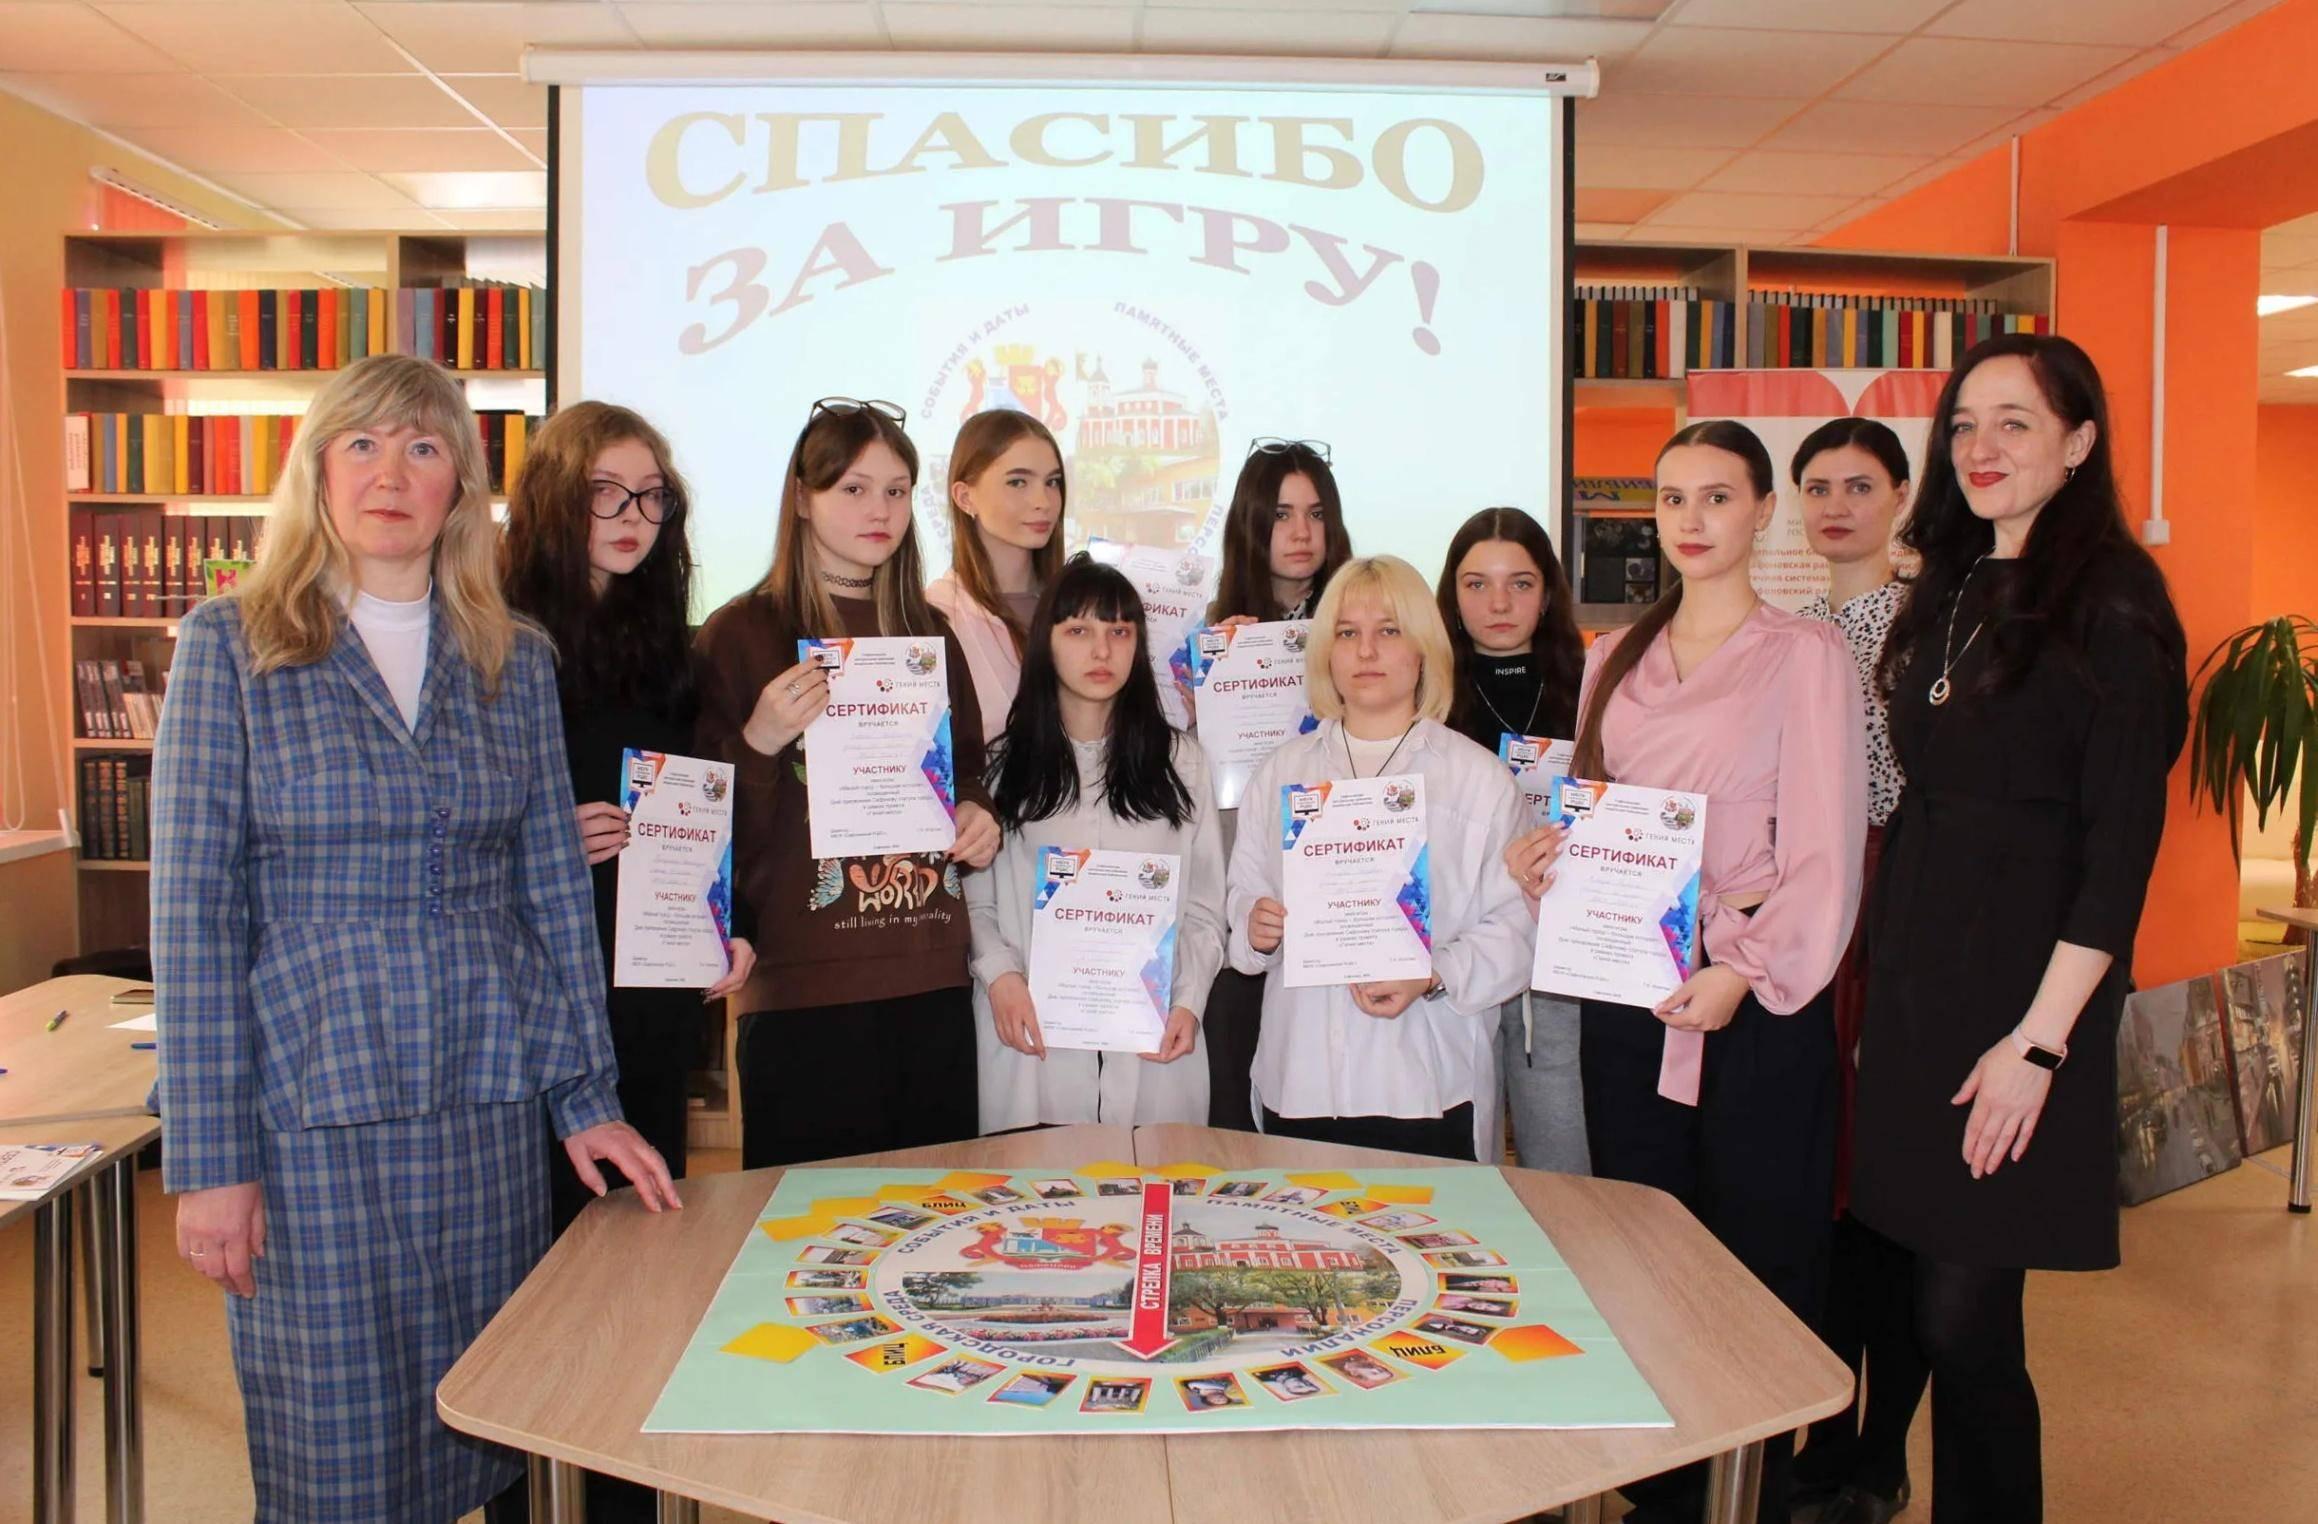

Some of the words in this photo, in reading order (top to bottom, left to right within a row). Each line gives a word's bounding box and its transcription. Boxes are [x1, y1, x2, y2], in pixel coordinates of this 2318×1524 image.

[644, 111, 1486, 214] СПАСИБО
[678, 220, 895, 357] ЗА
[935, 198, 1443, 357] ИГРУ!
[921, 343, 969, 420] СОБЫТИЯ
[969, 331, 982, 344] И
[984, 303, 1030, 335] ДАТЫ
[1114, 301, 1200, 364] ПАМЯТНЫЕ
[1197, 363, 1229, 421] МЕСТА
[1187, 503, 1224, 556] ПЕРСО
[1143, 602, 1188, 618] ФИКАТ
[1495, 666, 1527, 676] INSPIRE
[1213, 674, 1304, 693] СЕРТИФИКАТ
[826, 702, 928, 718] СЕРТИФИКАТ
[1238, 730, 1285, 740] УЧАСТНИКУ
[853, 765, 906, 775] УЧАСТНИКУ
[638, 822, 717, 843] СЕРТИФИКАТ
[1304, 838, 1405, 857] СЕРТИФИКАТ
[1569, 843, 1677, 870] СЕРТИФИКАТ
[654, 891, 697, 903] УЧАСТНИКУ
[1328, 898, 1382, 909] УЧАСТНИКУ
[833, 916, 857, 930] still
[861, 916, 886, 928] living
[889, 913, 900, 924] in
[904, 916, 918, 927] my
[1055, 908, 1155, 926] СЕРТИФИКАТ
[1586, 909, 1643, 925] УЧАСТНИКУ
[1073, 967, 1125, 977] УЧАСТНИКУ
[922, 1201, 967, 1209] БЛИЦ
[897, 1215, 981, 1254] СОБЫТИЯ
[1007, 1201, 1076, 1212] ДАТЫ
[1143, 1214, 1164, 1255] ВРЕМЕНИ
[1206, 1199, 1344, 1227] ПАМЯТНЫЕ
[1345, 1226, 1401, 1256] МЕСТА
[1140, 1262, 1162, 1310] СТРЕЛКА
[883, 1290, 925, 1321] СРЕДА
[1281, 1299, 1418, 1358] ПЕРСОНАЛИИ
[920, 1322, 1076, 1368] ГОРОДСКАЯ
[1390, 1344, 1447, 1358] БЛИЦ
